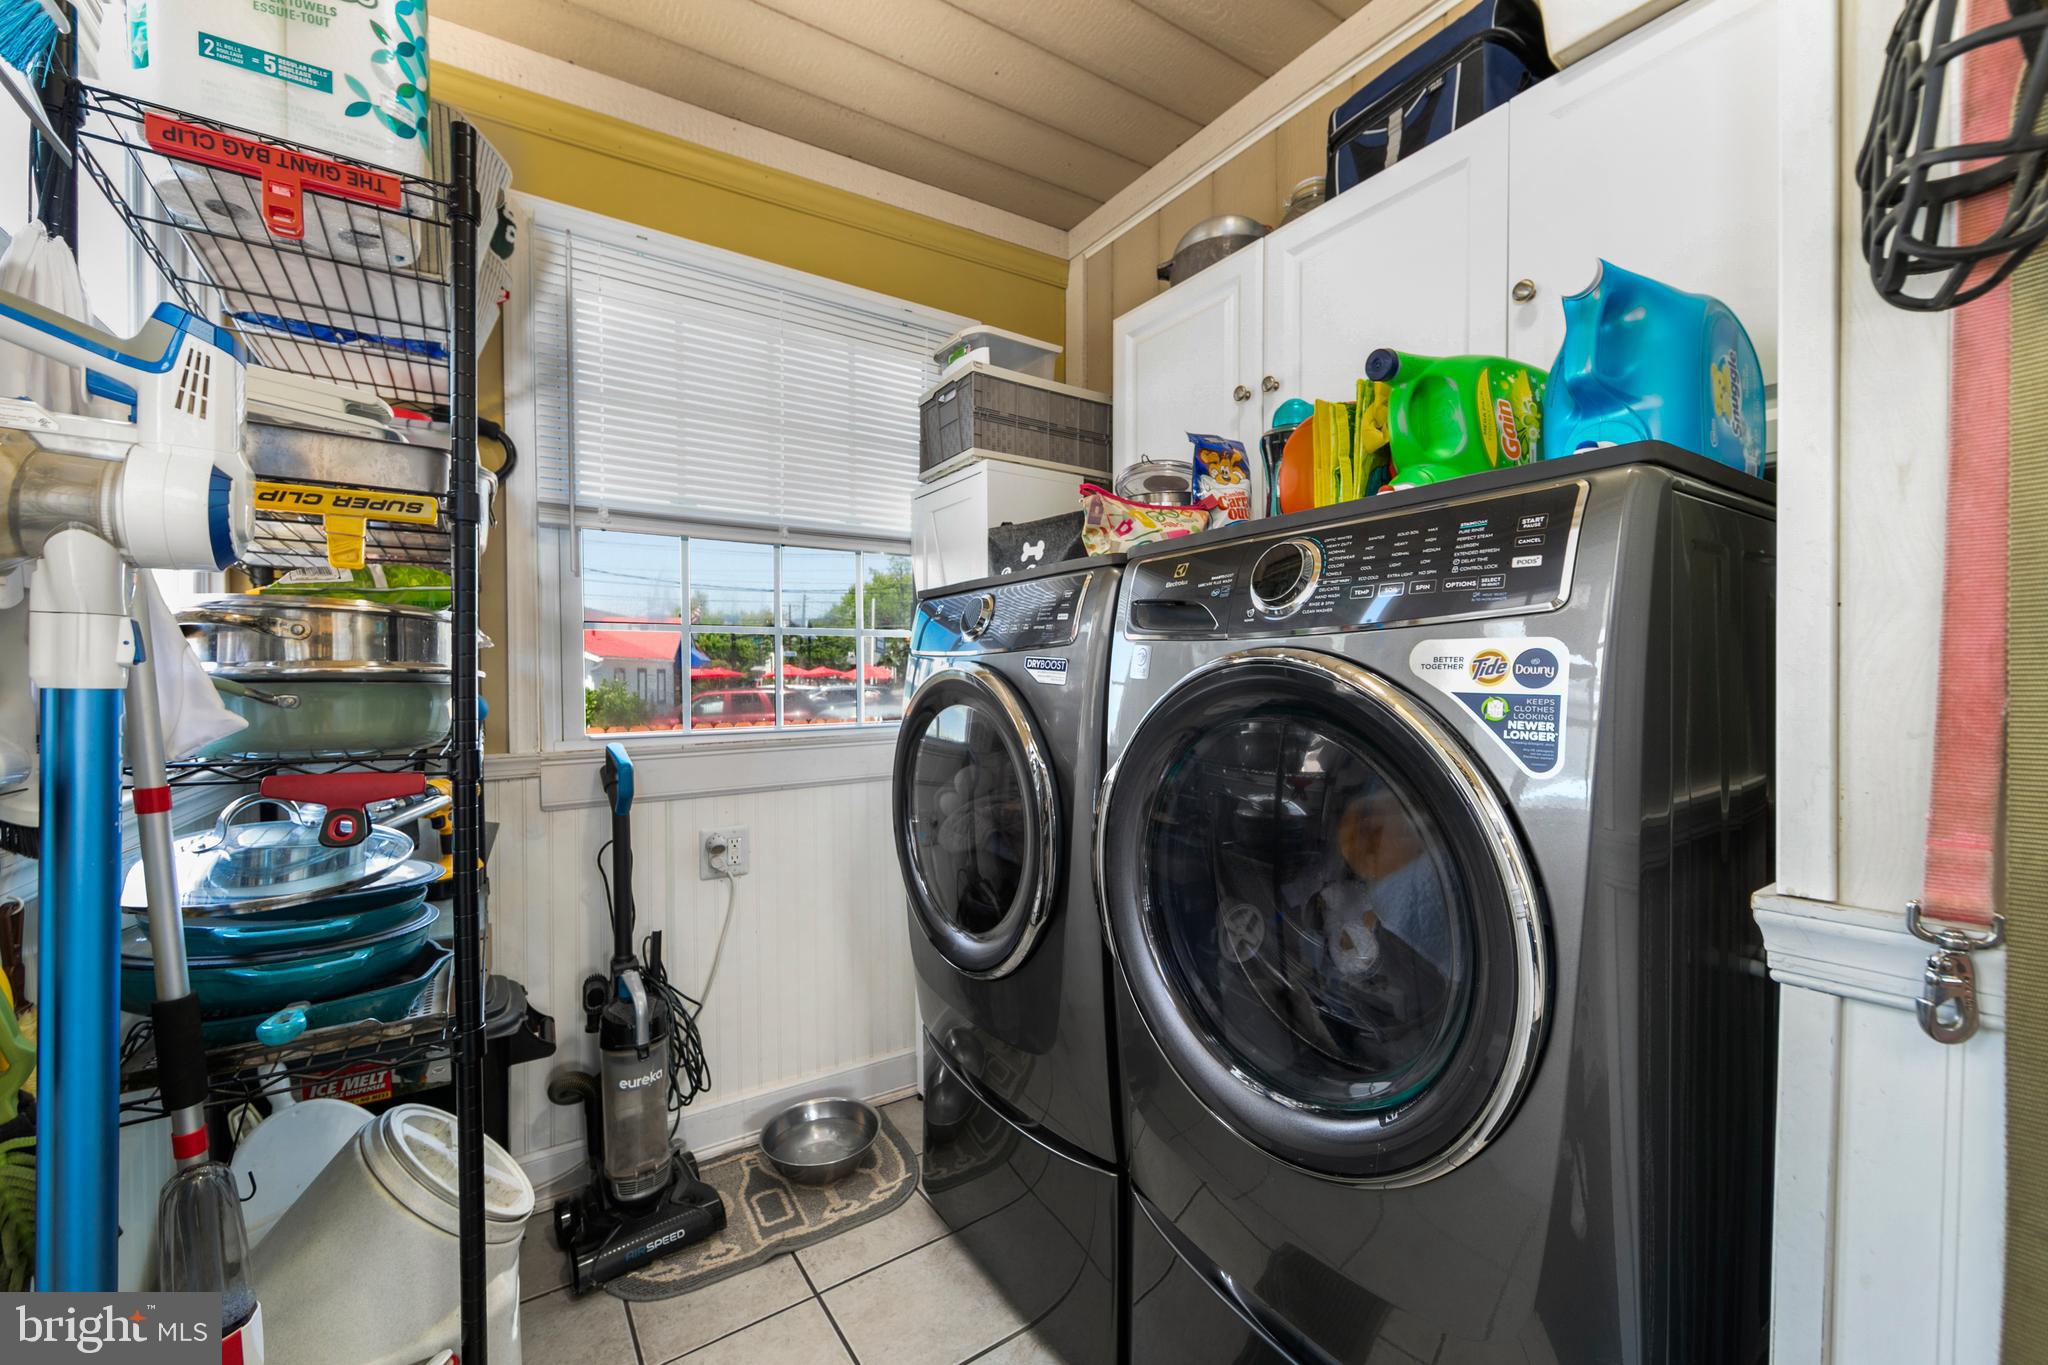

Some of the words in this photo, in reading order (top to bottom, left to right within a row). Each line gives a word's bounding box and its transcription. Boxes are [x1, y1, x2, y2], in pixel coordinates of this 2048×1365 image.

[252, 0, 330, 28] ESSUIE-TOUT
[204, 38, 215, 57] 2
[224, 44, 241, 54] ROLLS
[264, 53, 276, 74] 5
[278, 58, 307, 72] REGULAR
[278, 64, 312, 78] ROULEAUX
[162, 125, 215, 148] CLIP
[222, 140, 271, 164] BAG
[276, 156, 341, 181] GIANT
[346, 177, 387, 195] THE
[1728, 349, 1742, 438] Snuggle
[1498, 398, 1522, 461] Gain
[258, 490, 323, 506] CLIP
[332, 495, 424, 514] SUPER
[1522, 516, 1544, 524] START
[1166, 580, 1188, 588] Electrolux
[1445, 580, 1476, 589] OPTIONS
[1027, 659, 1066, 670] DRYBOOST
[1472, 658, 1508, 680] Tide
[1516, 664, 1554, 678] Downy
[1508, 721, 1555, 732] NEWER
[309, 1081, 337, 1098] ICE
[341, 1070, 388, 1091] MELT
[619, 1068, 663, 1089] eureka
[346, 1084, 386, 1096] DISPENSER
[624, 1228, 686, 1262] AIRSPEED
